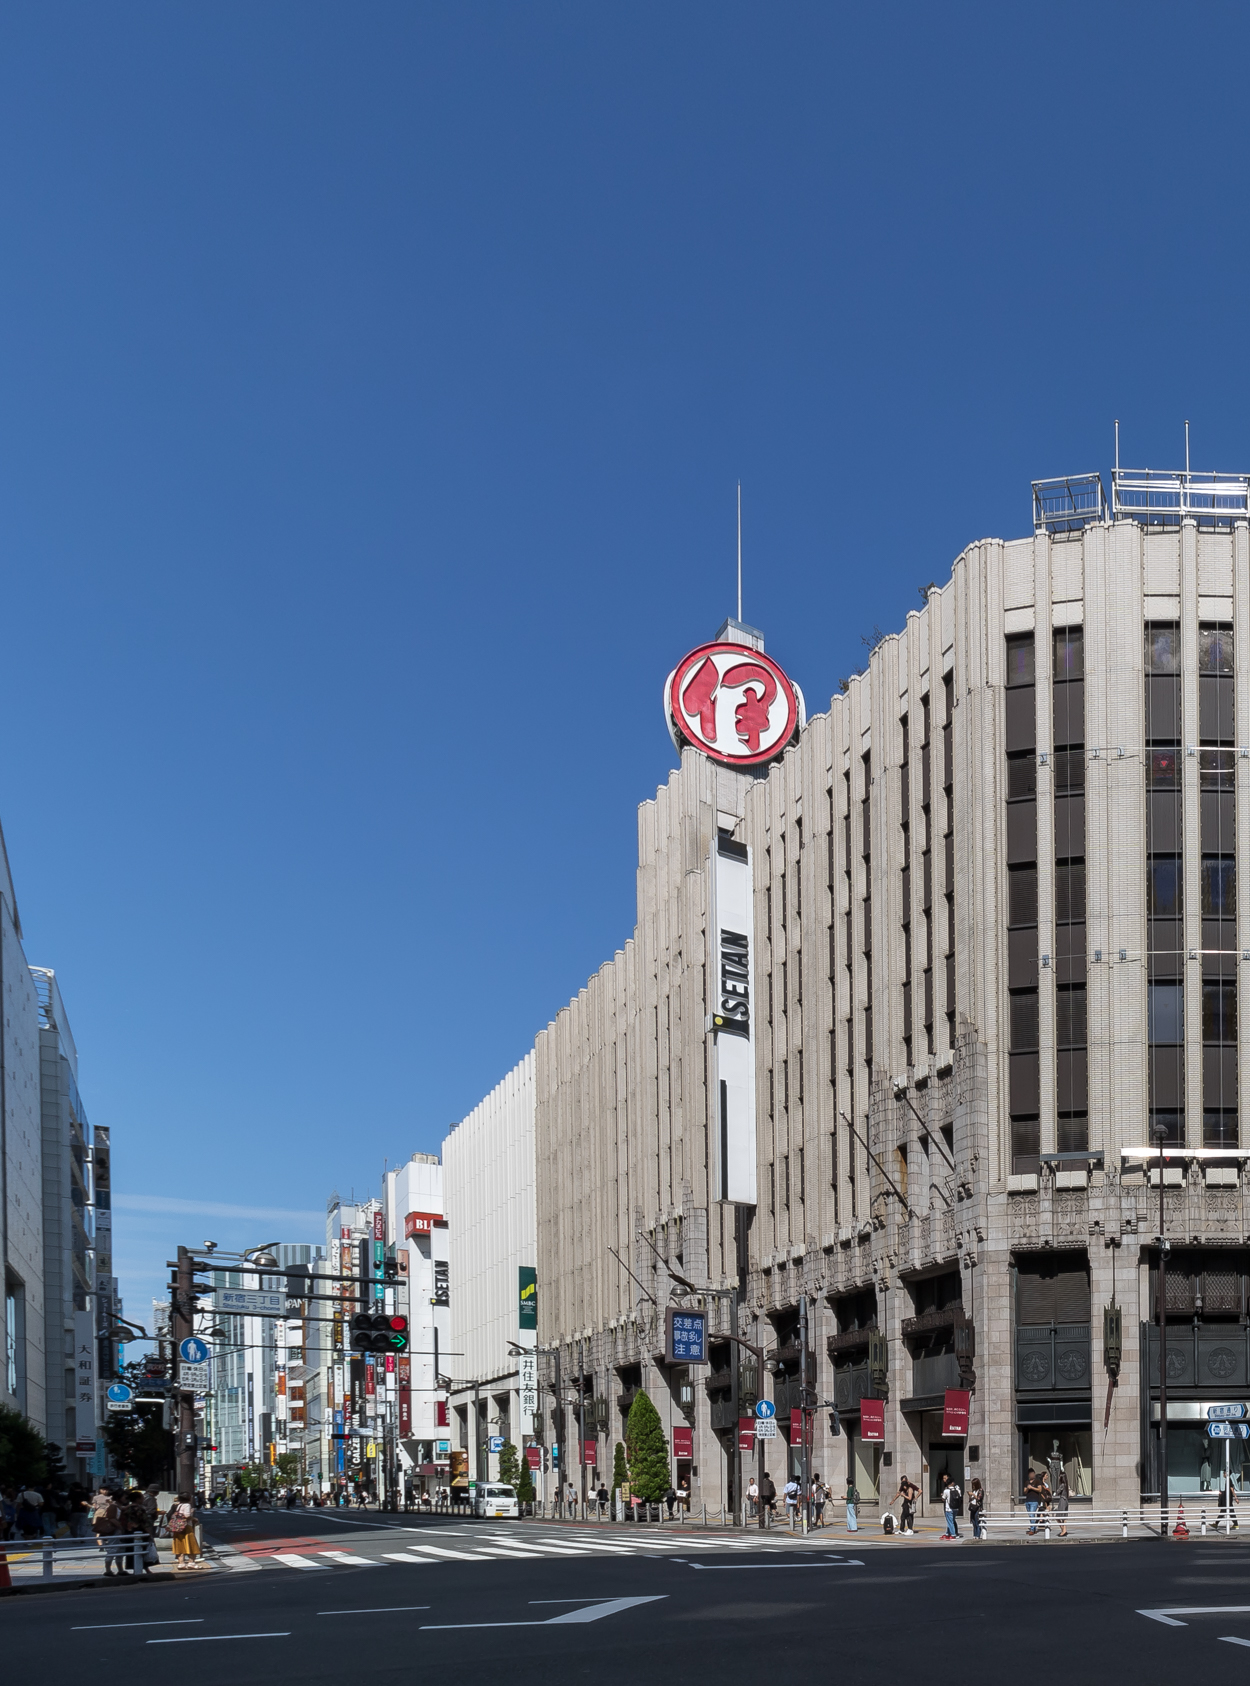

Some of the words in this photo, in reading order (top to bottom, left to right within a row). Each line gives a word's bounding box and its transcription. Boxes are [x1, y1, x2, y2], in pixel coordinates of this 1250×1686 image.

[719, 928, 750, 1042] ISETAN
[222, 1292, 280, 1306] 新宿三丁目
[223, 1302, 250, 1311] Shinjuku
[673, 1317, 702, 1330] 交差点
[675, 1343, 700, 1355] 注意
[77, 1344, 93, 1403] 大和証券
